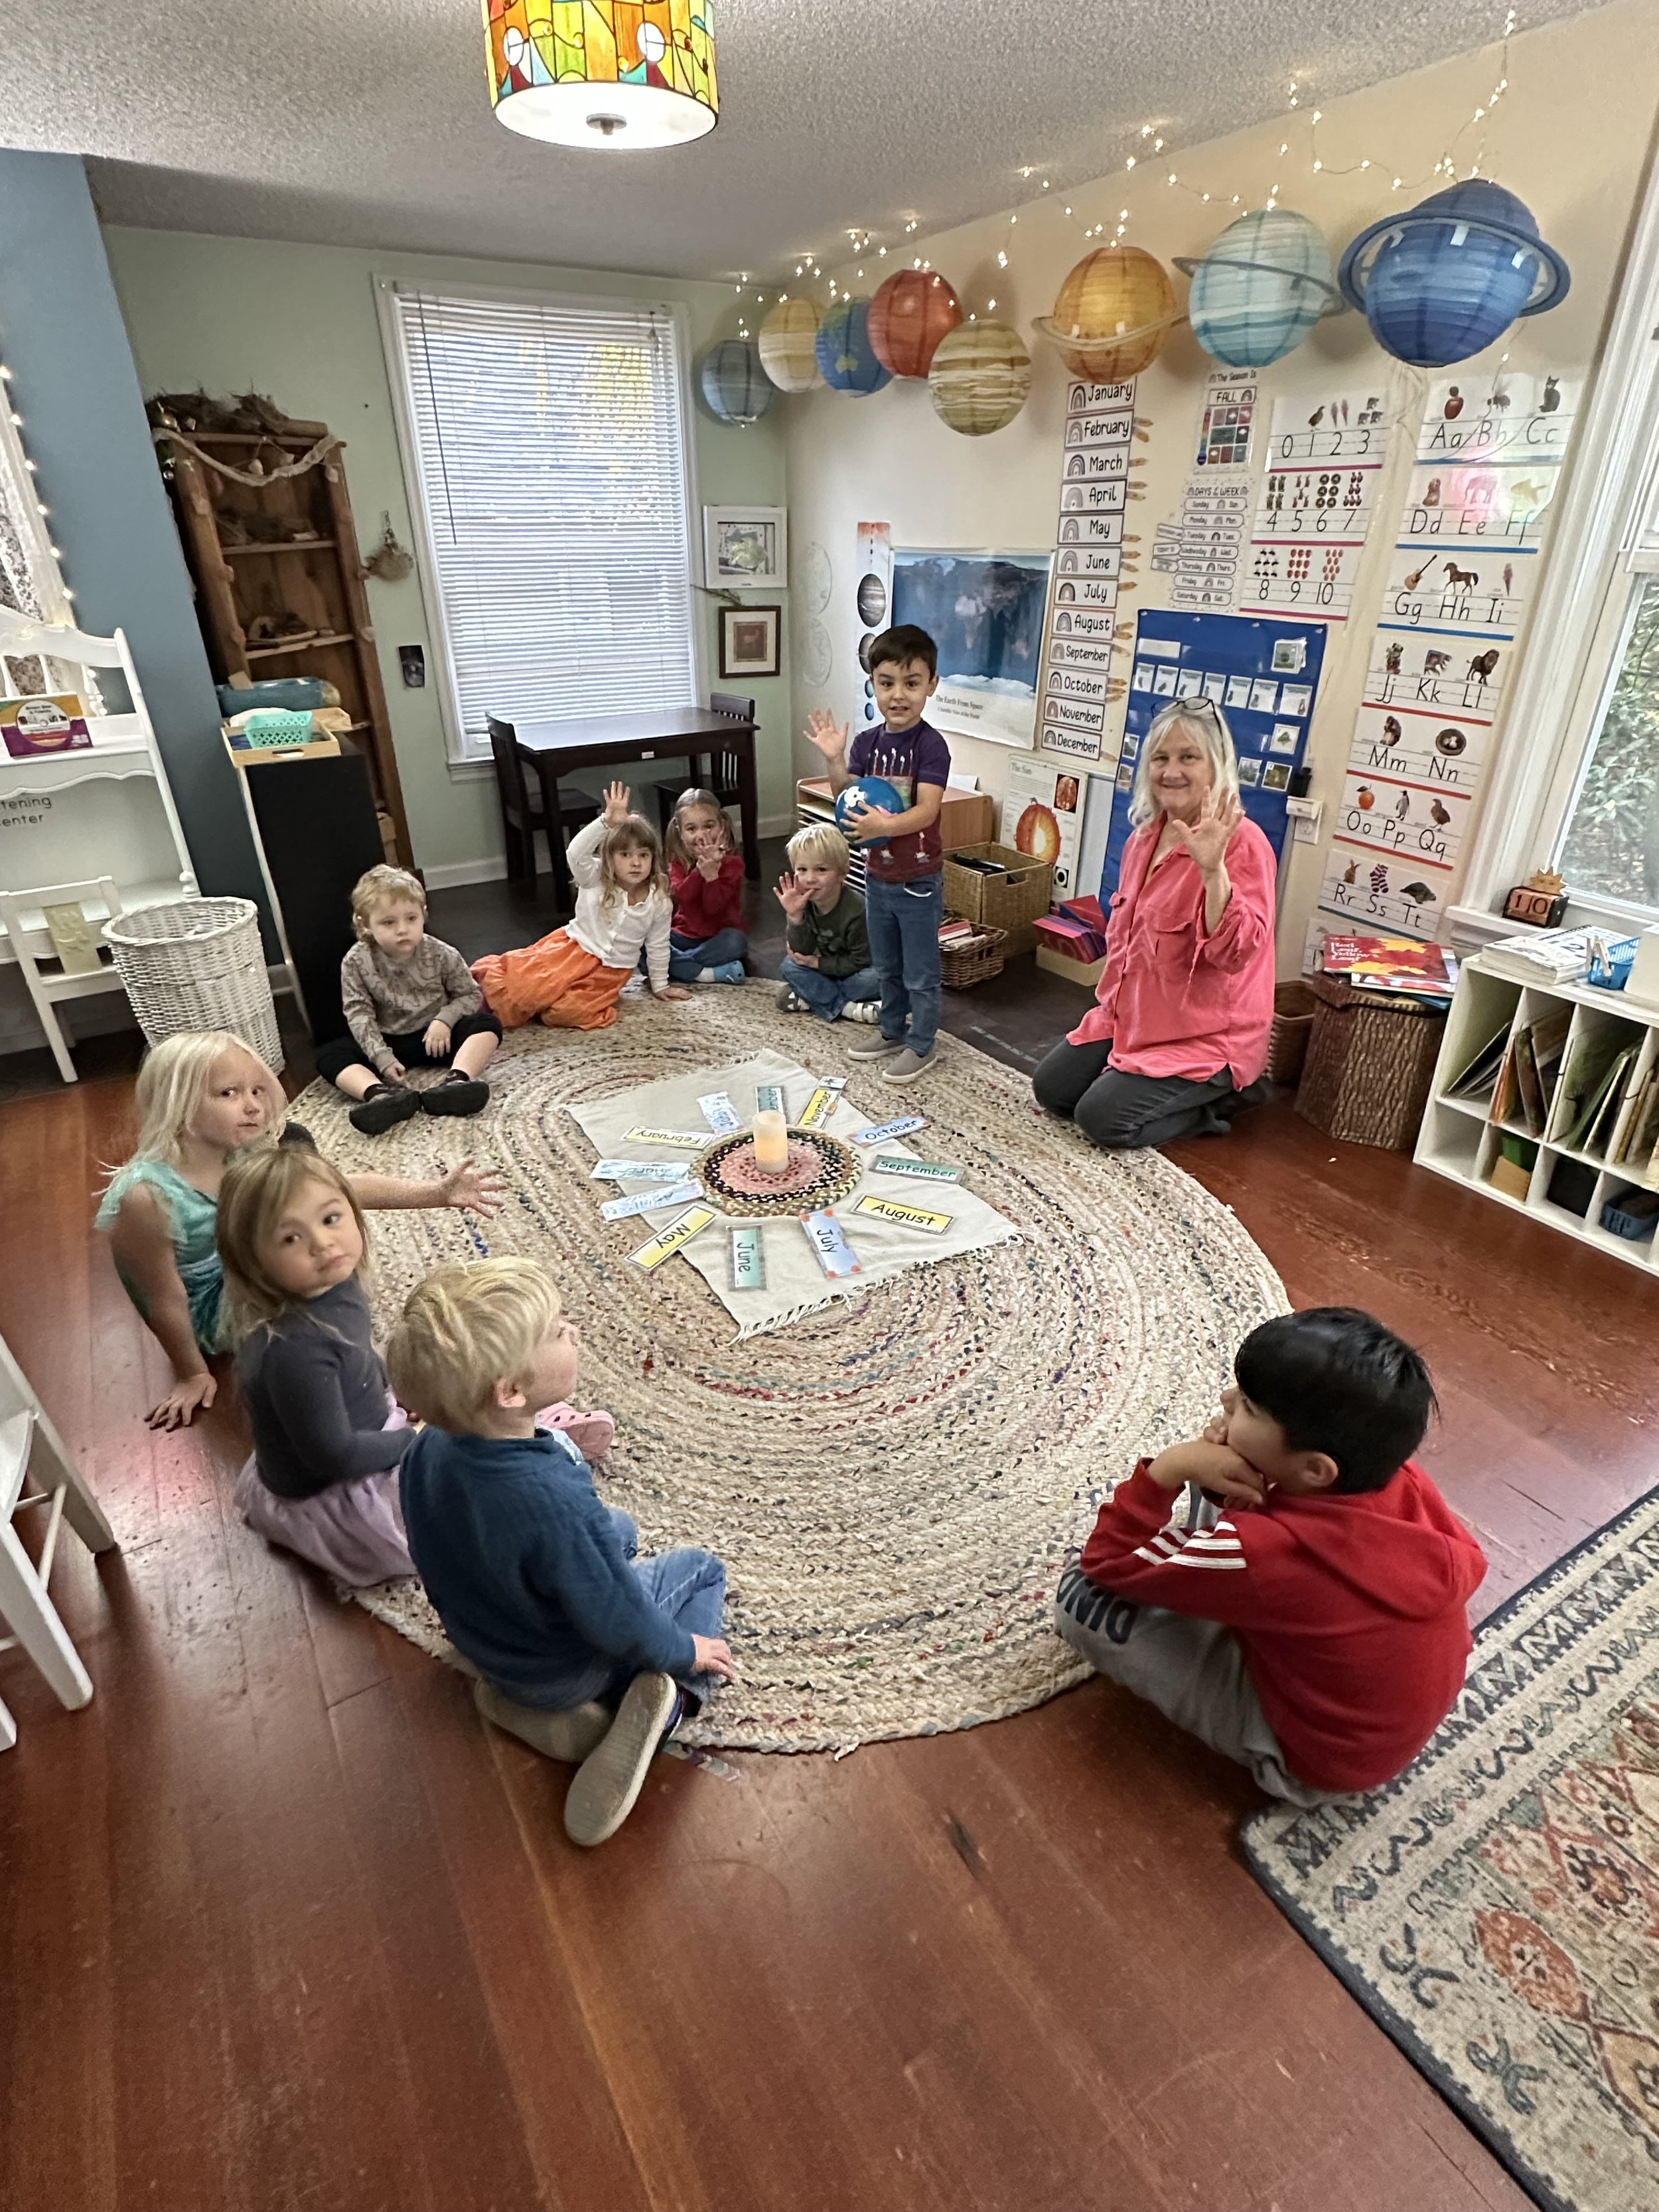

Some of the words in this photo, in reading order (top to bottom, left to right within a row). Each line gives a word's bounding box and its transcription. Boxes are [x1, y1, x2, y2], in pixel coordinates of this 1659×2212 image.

[1088, 384, 1133, 402] January
[1216, 392, 1237, 404] FALL
[1084, 419, 1129, 437] February
[1331, 432, 1342, 455] 2
[1358, 429, 1370, 454] 3
[1090, 455, 1123, 473] March
[1089, 487, 1118, 506] April
[1090, 520, 1111, 539] May
[1267, 510, 1278, 532] 4
[1291, 510, 1303, 532] 5
[1316, 510, 1328, 532] 6
[1342, 509, 1356, 531] 7
[1086, 555, 1110, 570] June
[1084, 583, 1107, 603] July
[1259, 579, 1270, 600] 8
[1291, 581, 1301, 603] 9
[1316, 582, 1334, 605] 10
[1074, 615, 1110, 634] August
[1066, 645, 1108, 662] September
[1064, 676, 1103, 695] October
[1059, 702, 1102, 725] November
[1056, 733, 1098, 755] December
[0, 796, 52, 810] tening
[0, 814, 44, 827] enter
[764, 1088, 779, 1110] ember
[804, 1090, 831, 1126] November
[635, 1129, 701, 1145] February
[865, 1119, 918, 1141] October
[878, 1160, 957, 1178] September
[870, 1203, 936, 1226] August
[656, 1223, 691, 1249] May
[816, 1228, 837, 1254] July
[737, 1242, 755, 1273] June
